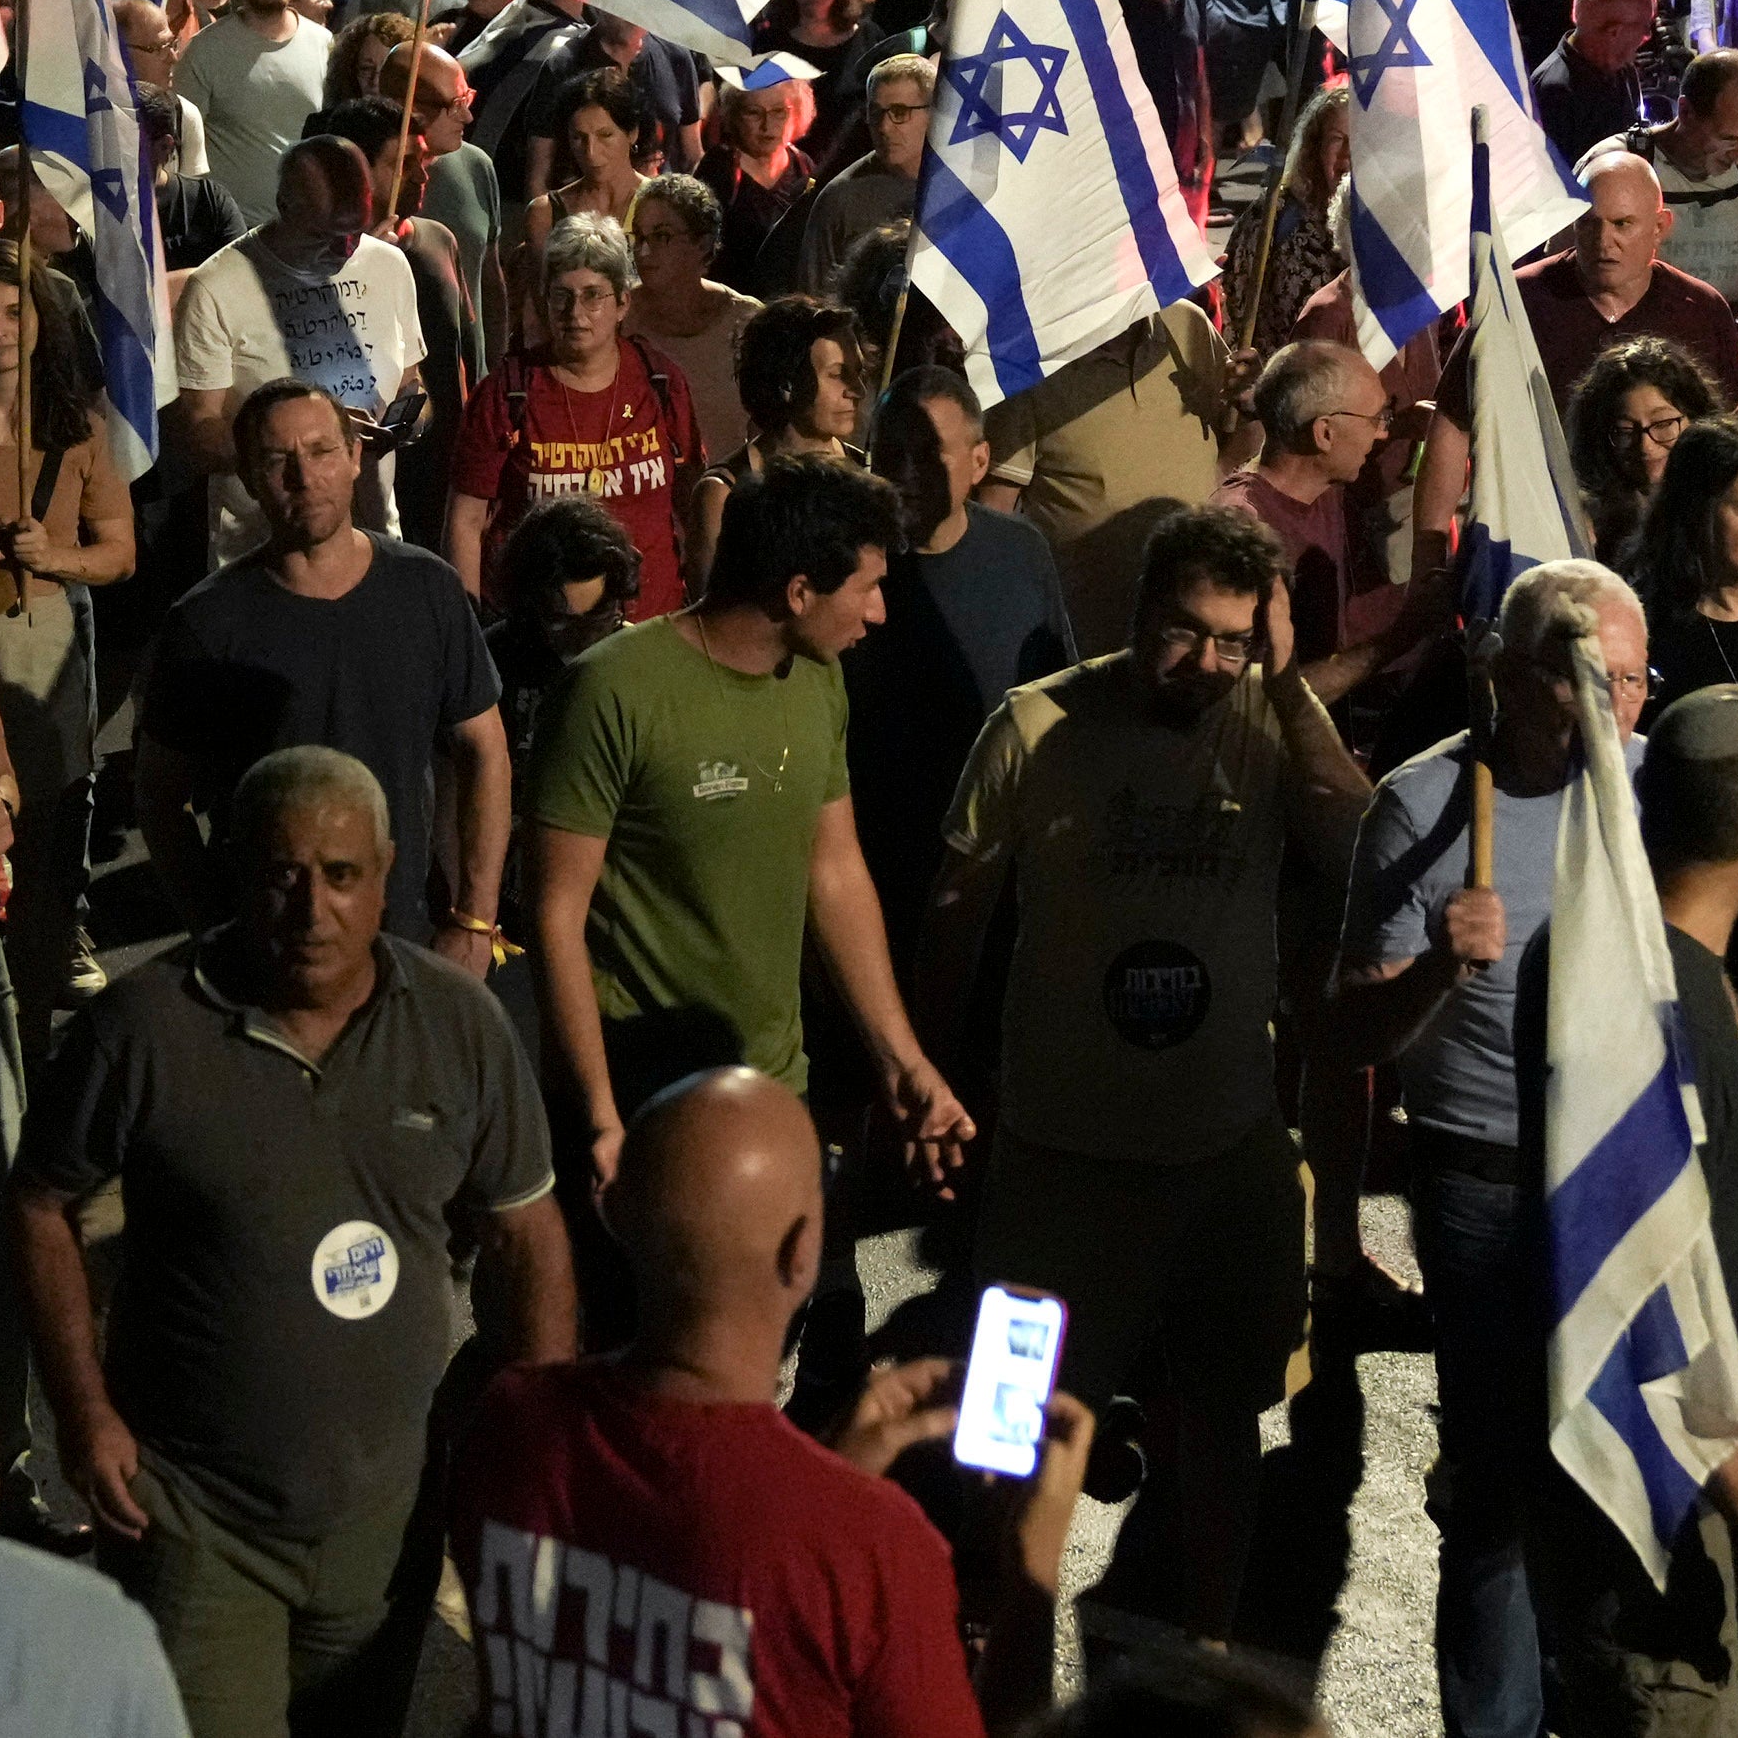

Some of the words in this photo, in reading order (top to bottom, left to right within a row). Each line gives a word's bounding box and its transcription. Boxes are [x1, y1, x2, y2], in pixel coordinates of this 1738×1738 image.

[530, 437, 625, 471] דמוקרטיה
[626, 426, 660, 455] בלי
[527, 467, 623, 502] אדמיה
[629, 456, 667, 495] אין
[475, 1519, 755, 1720] בחירות
